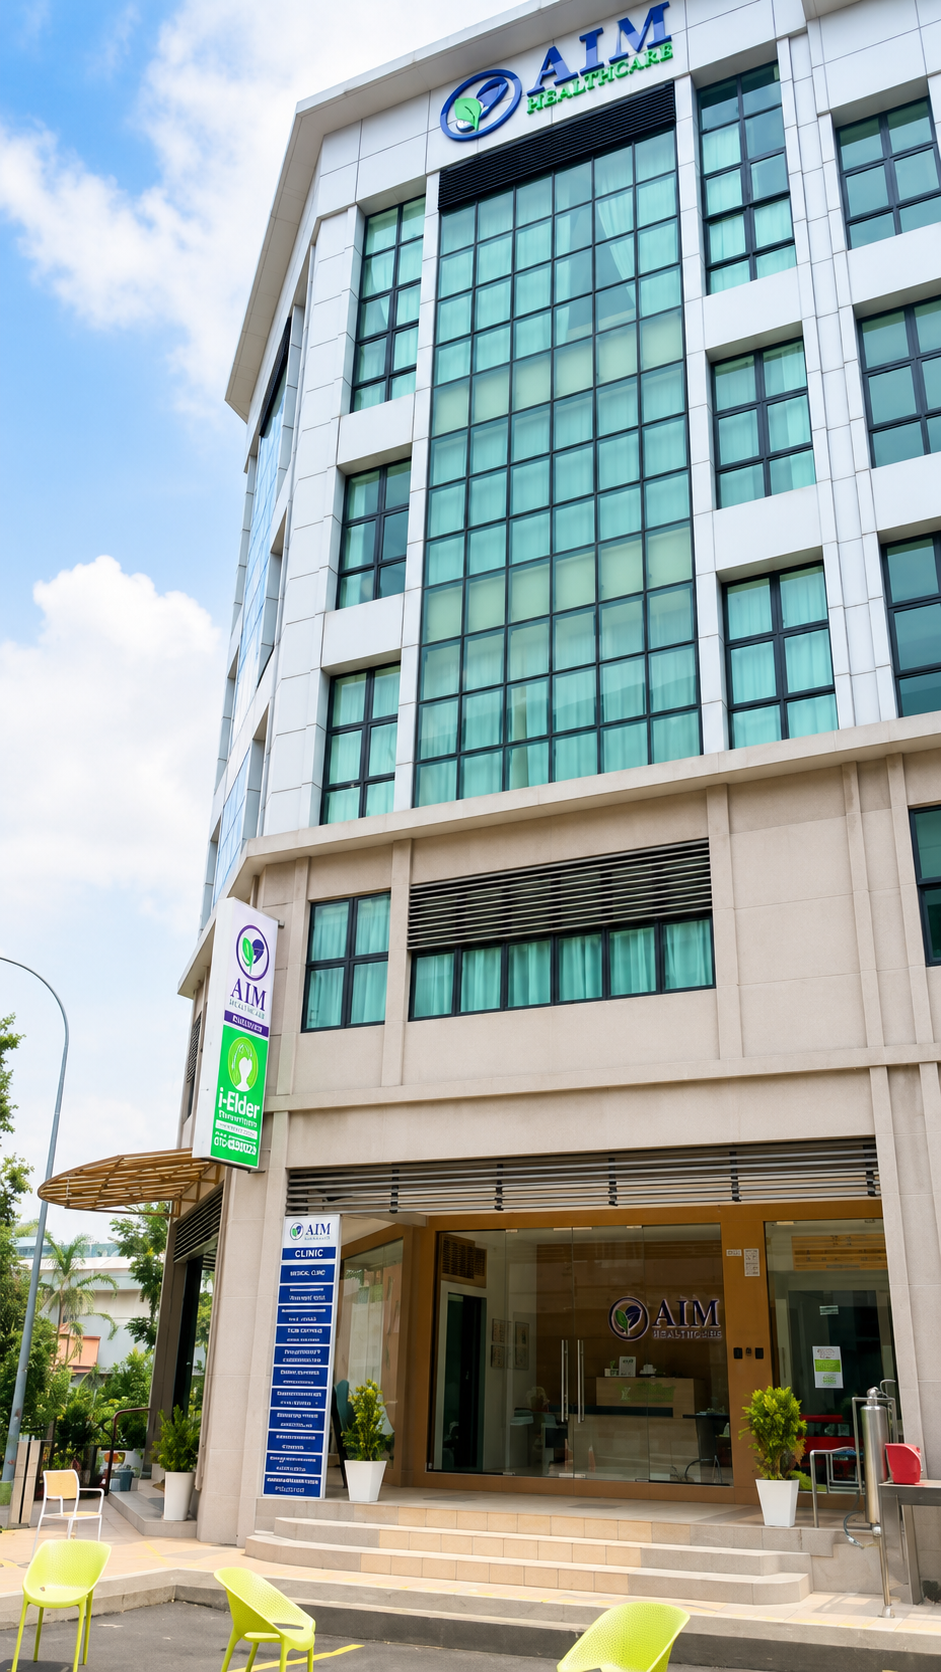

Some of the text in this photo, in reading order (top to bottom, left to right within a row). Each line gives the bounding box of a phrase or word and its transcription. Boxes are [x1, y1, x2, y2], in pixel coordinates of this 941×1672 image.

[526, 1, 672, 97] AIM
[526, 43, 674, 115] HEALTHCARE
[230, 978, 267, 1012] AIM
[218, 1087, 260, 1119] i-Elder
[305, 1222, 331, 1236] AIM
[294, 1249, 324, 1258] CLINIC
[651, 1298, 721, 1329] AIM
